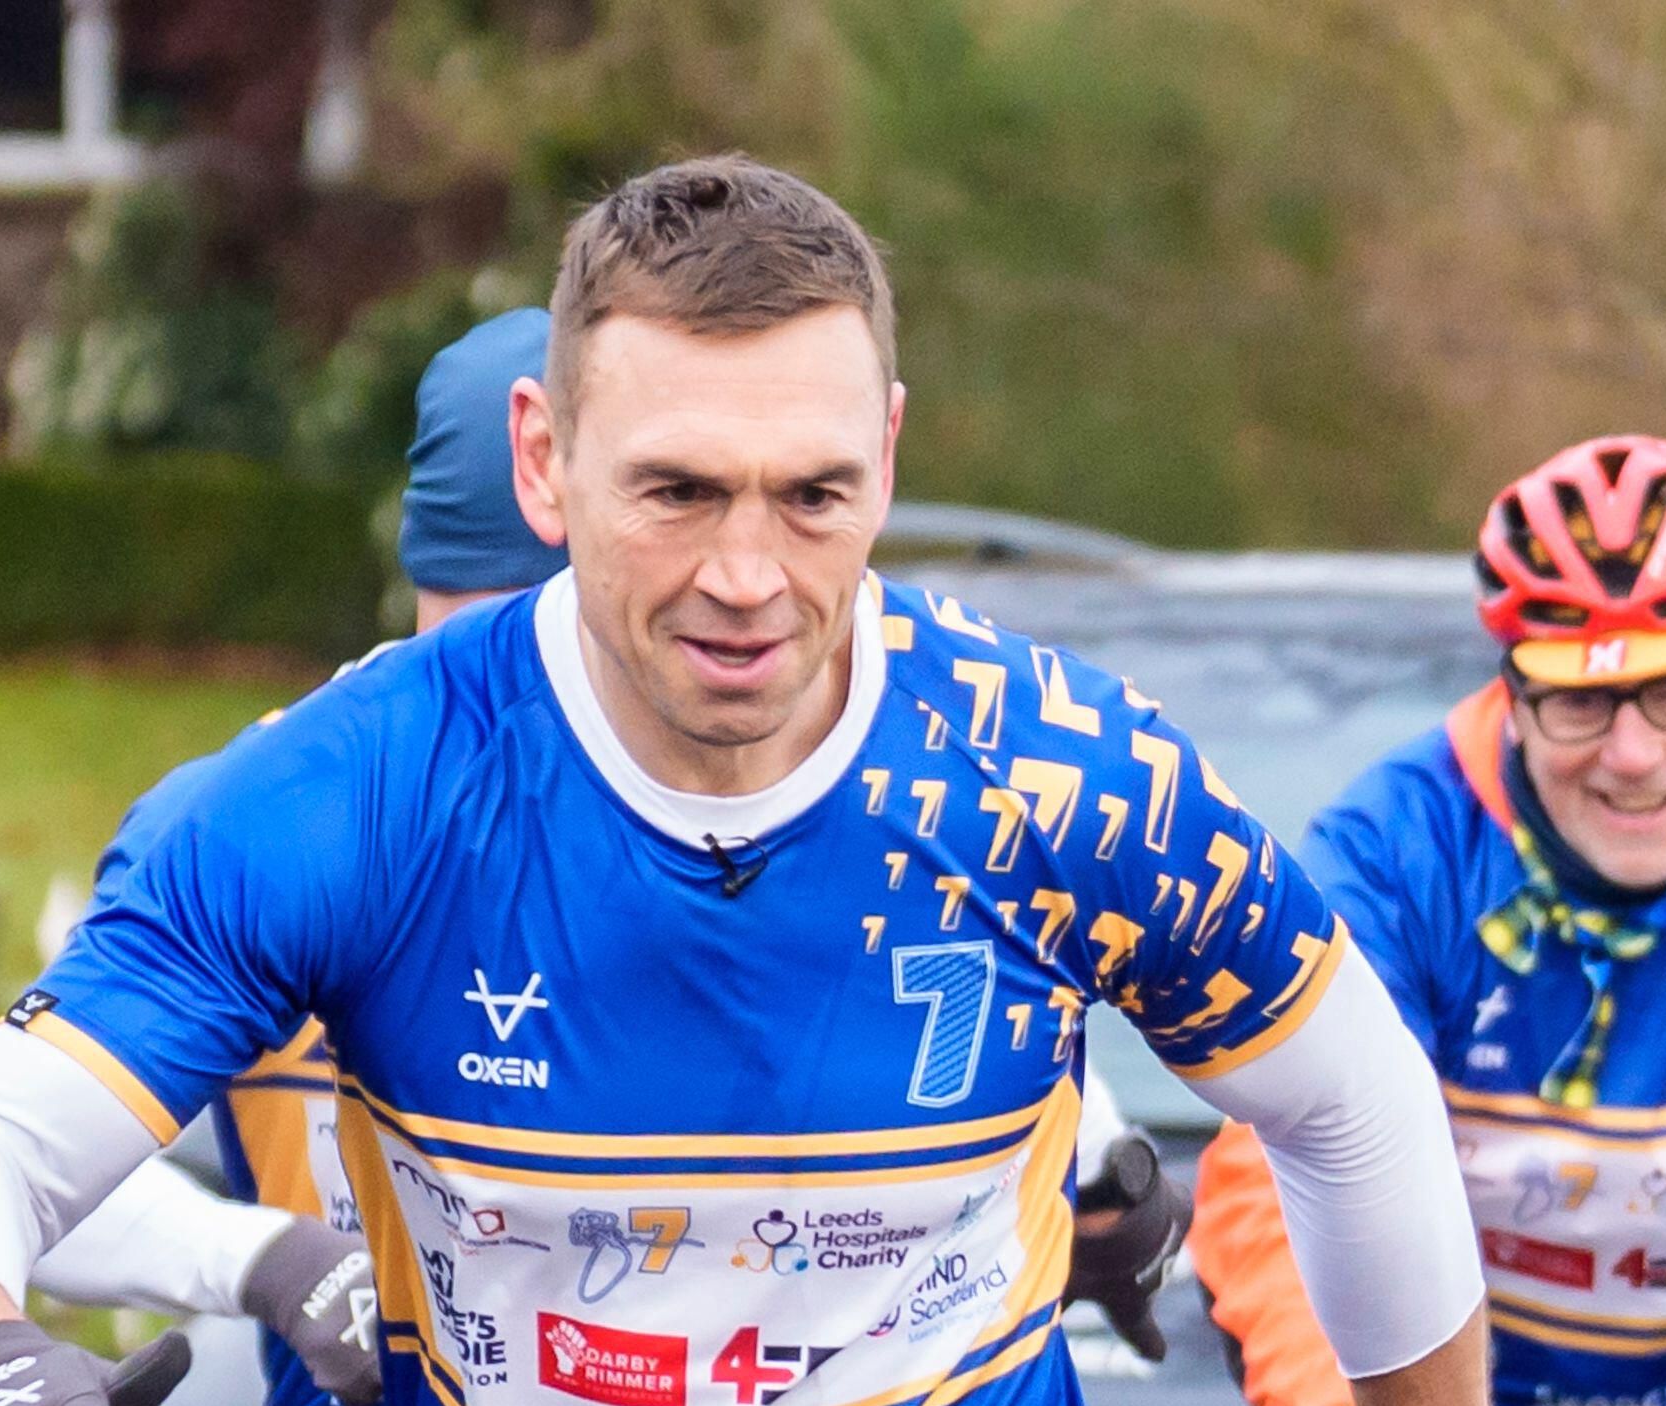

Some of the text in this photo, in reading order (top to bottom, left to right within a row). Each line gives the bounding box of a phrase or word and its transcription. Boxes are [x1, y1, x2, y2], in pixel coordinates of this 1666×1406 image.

[892, 940, 996, 1108] 7
[458, 1052, 549, 1089] OXEN
[804, 1208, 883, 1229] Leeds
[813, 1225, 928, 1249] Hospitals
[817, 1247, 909, 1270] Charity
[585, 1347, 660, 1373] DARBY
[584, 1364, 674, 1392] RIMMER
